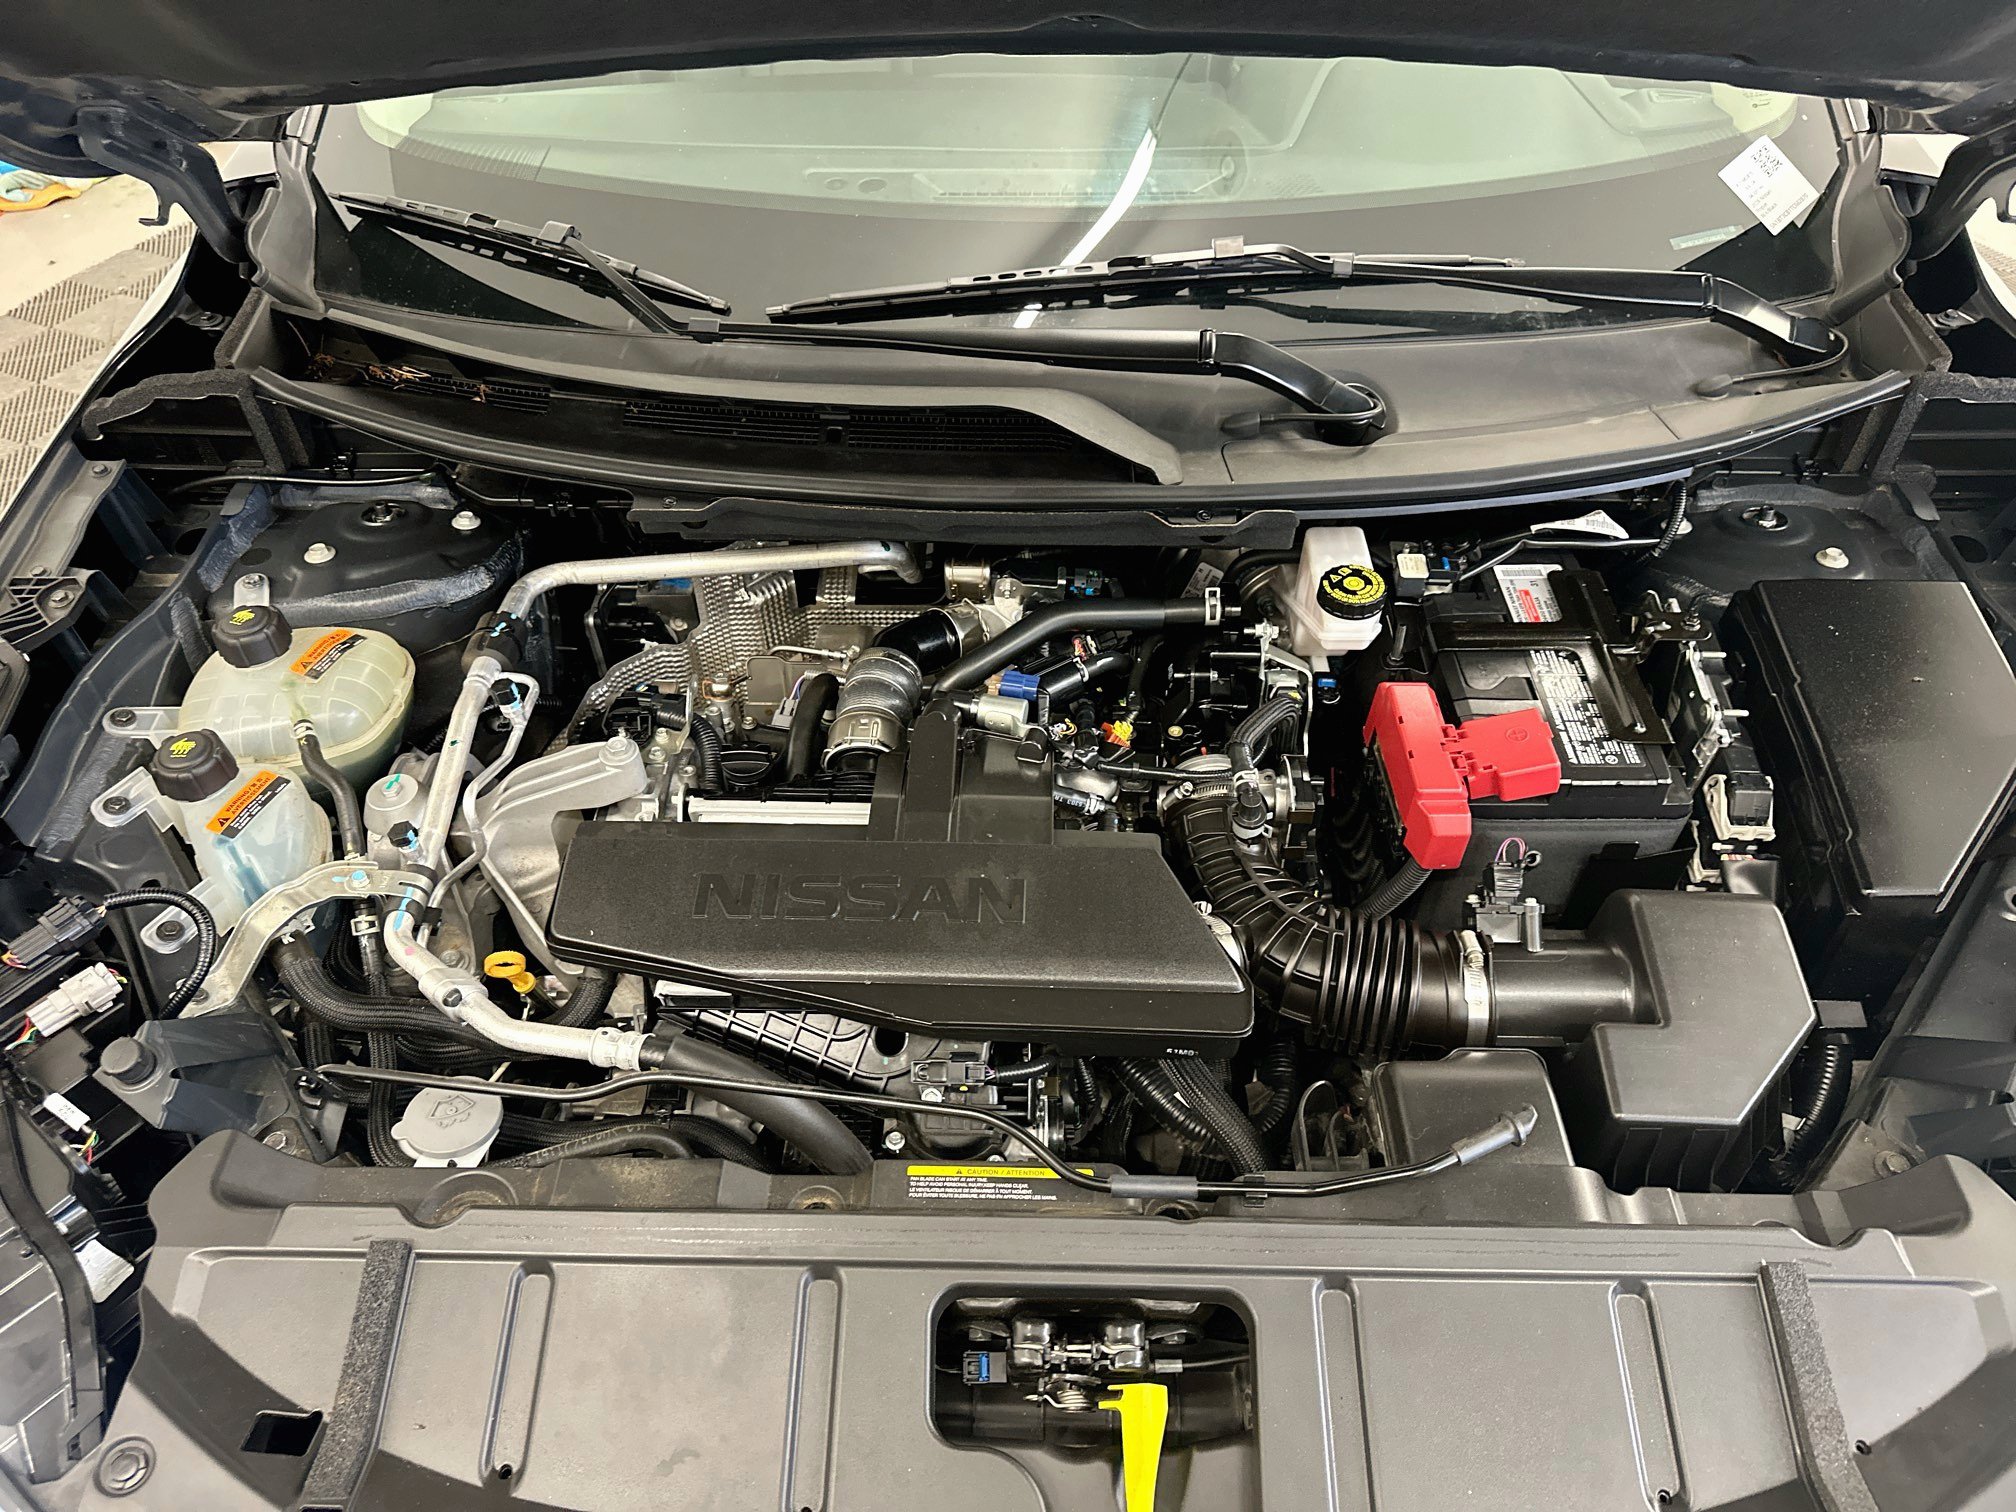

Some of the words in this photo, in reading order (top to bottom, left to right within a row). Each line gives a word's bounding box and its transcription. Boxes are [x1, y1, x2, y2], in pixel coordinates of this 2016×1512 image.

[225, 789, 249, 812] WARNING
[231, 776, 271, 815] AVERTISSEMENT
[692, 872, 1027, 924] NISSAN
